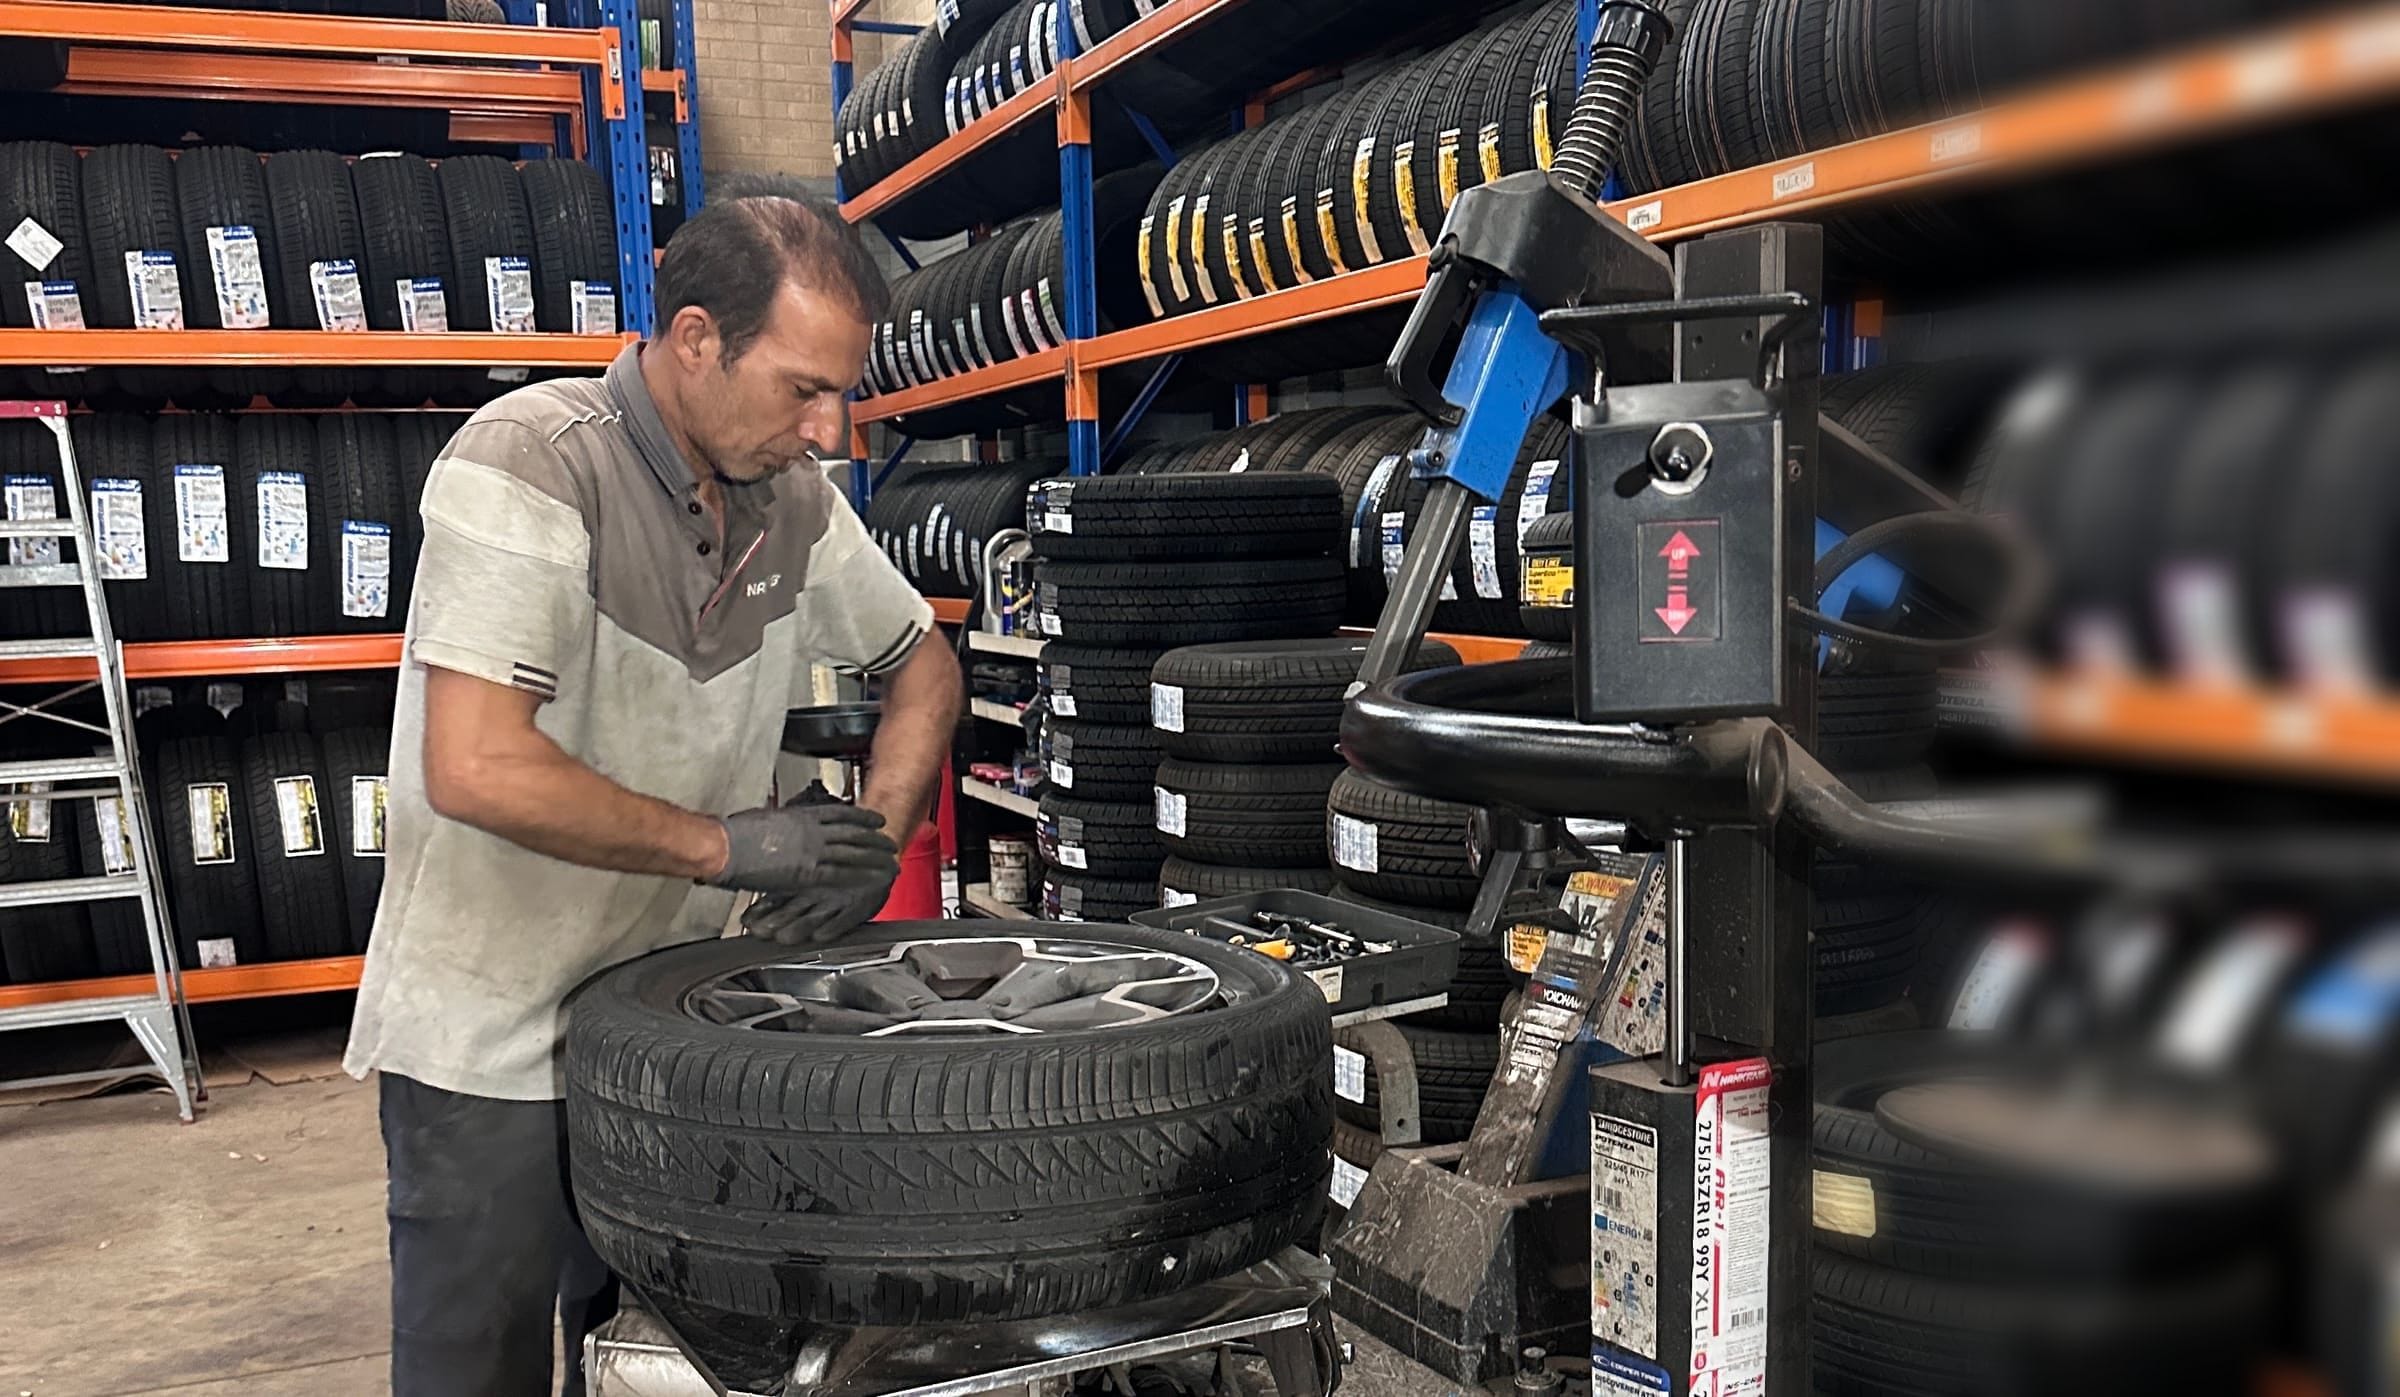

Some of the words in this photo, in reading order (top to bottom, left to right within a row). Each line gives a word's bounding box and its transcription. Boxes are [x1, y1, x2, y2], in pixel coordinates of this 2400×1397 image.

[1671, 547, 1687, 561] UP
[1697, 1120, 1712, 1239] 275/35ZR18
[1714, 1168, 1726, 1232] AR-1
[1695, 1244, 1710, 1282] 99Y
[1695, 1288, 1709, 1320] XL
